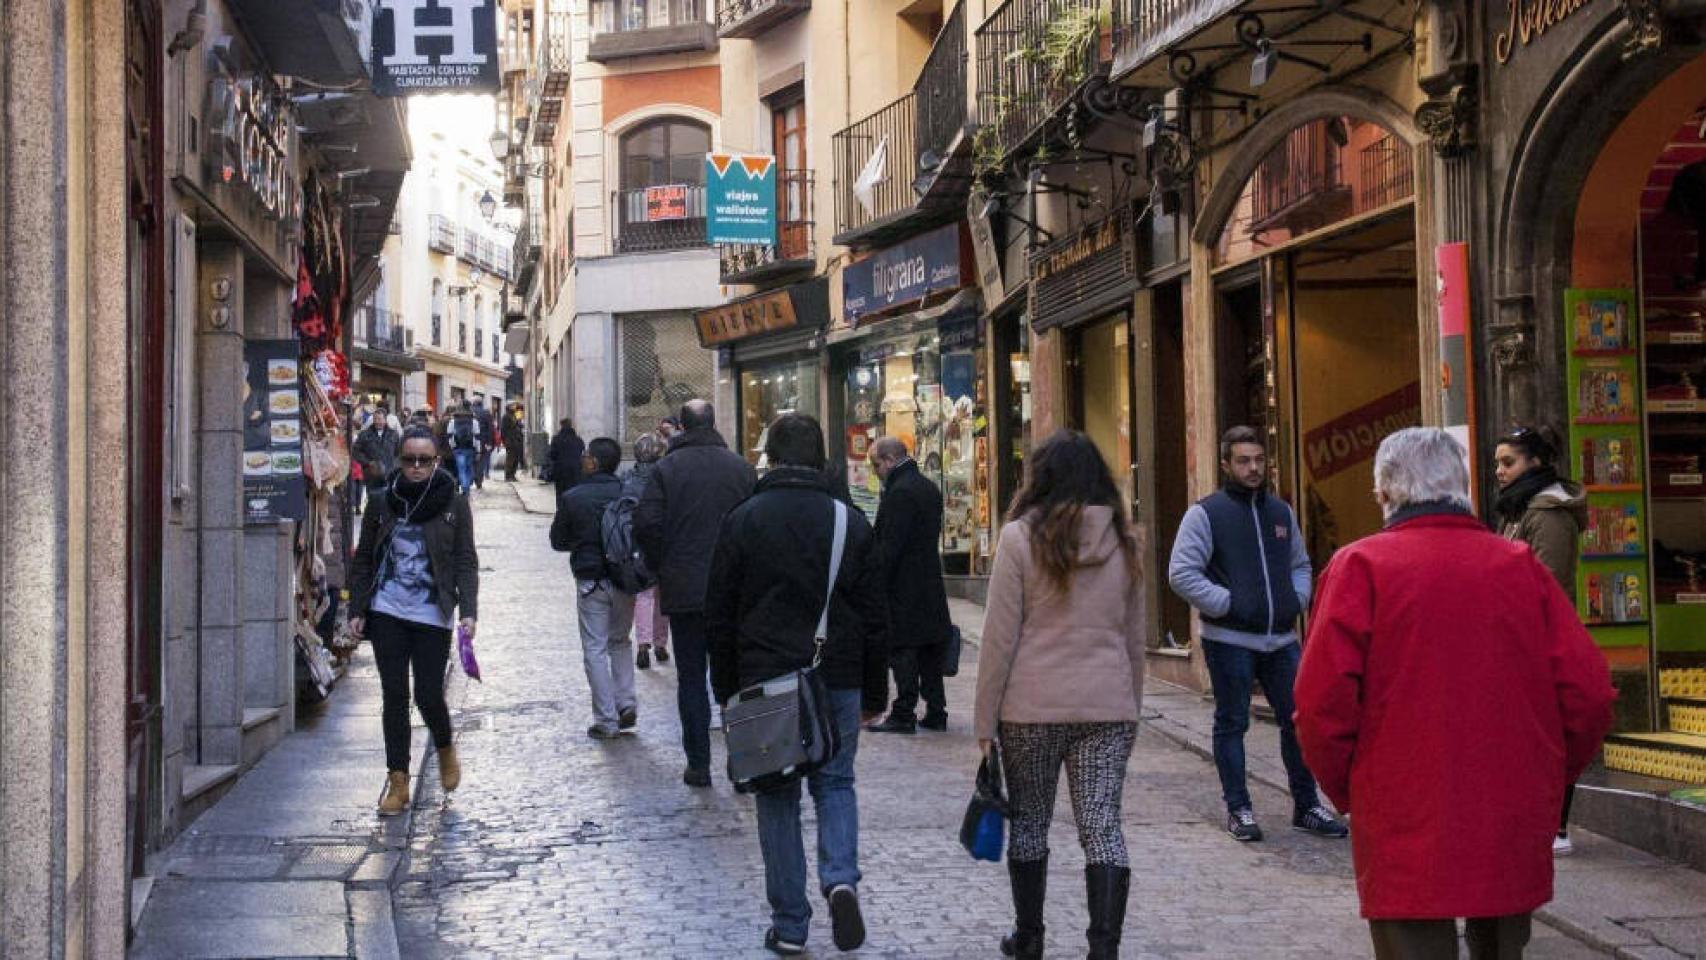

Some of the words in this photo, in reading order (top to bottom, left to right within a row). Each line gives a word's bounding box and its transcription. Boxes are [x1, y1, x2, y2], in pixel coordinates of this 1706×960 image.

[382, 0, 487, 65] H
[439, 65, 456, 75] CON
[725, 190, 759, 202] viajes
[873, 256, 925, 303] filigrana
